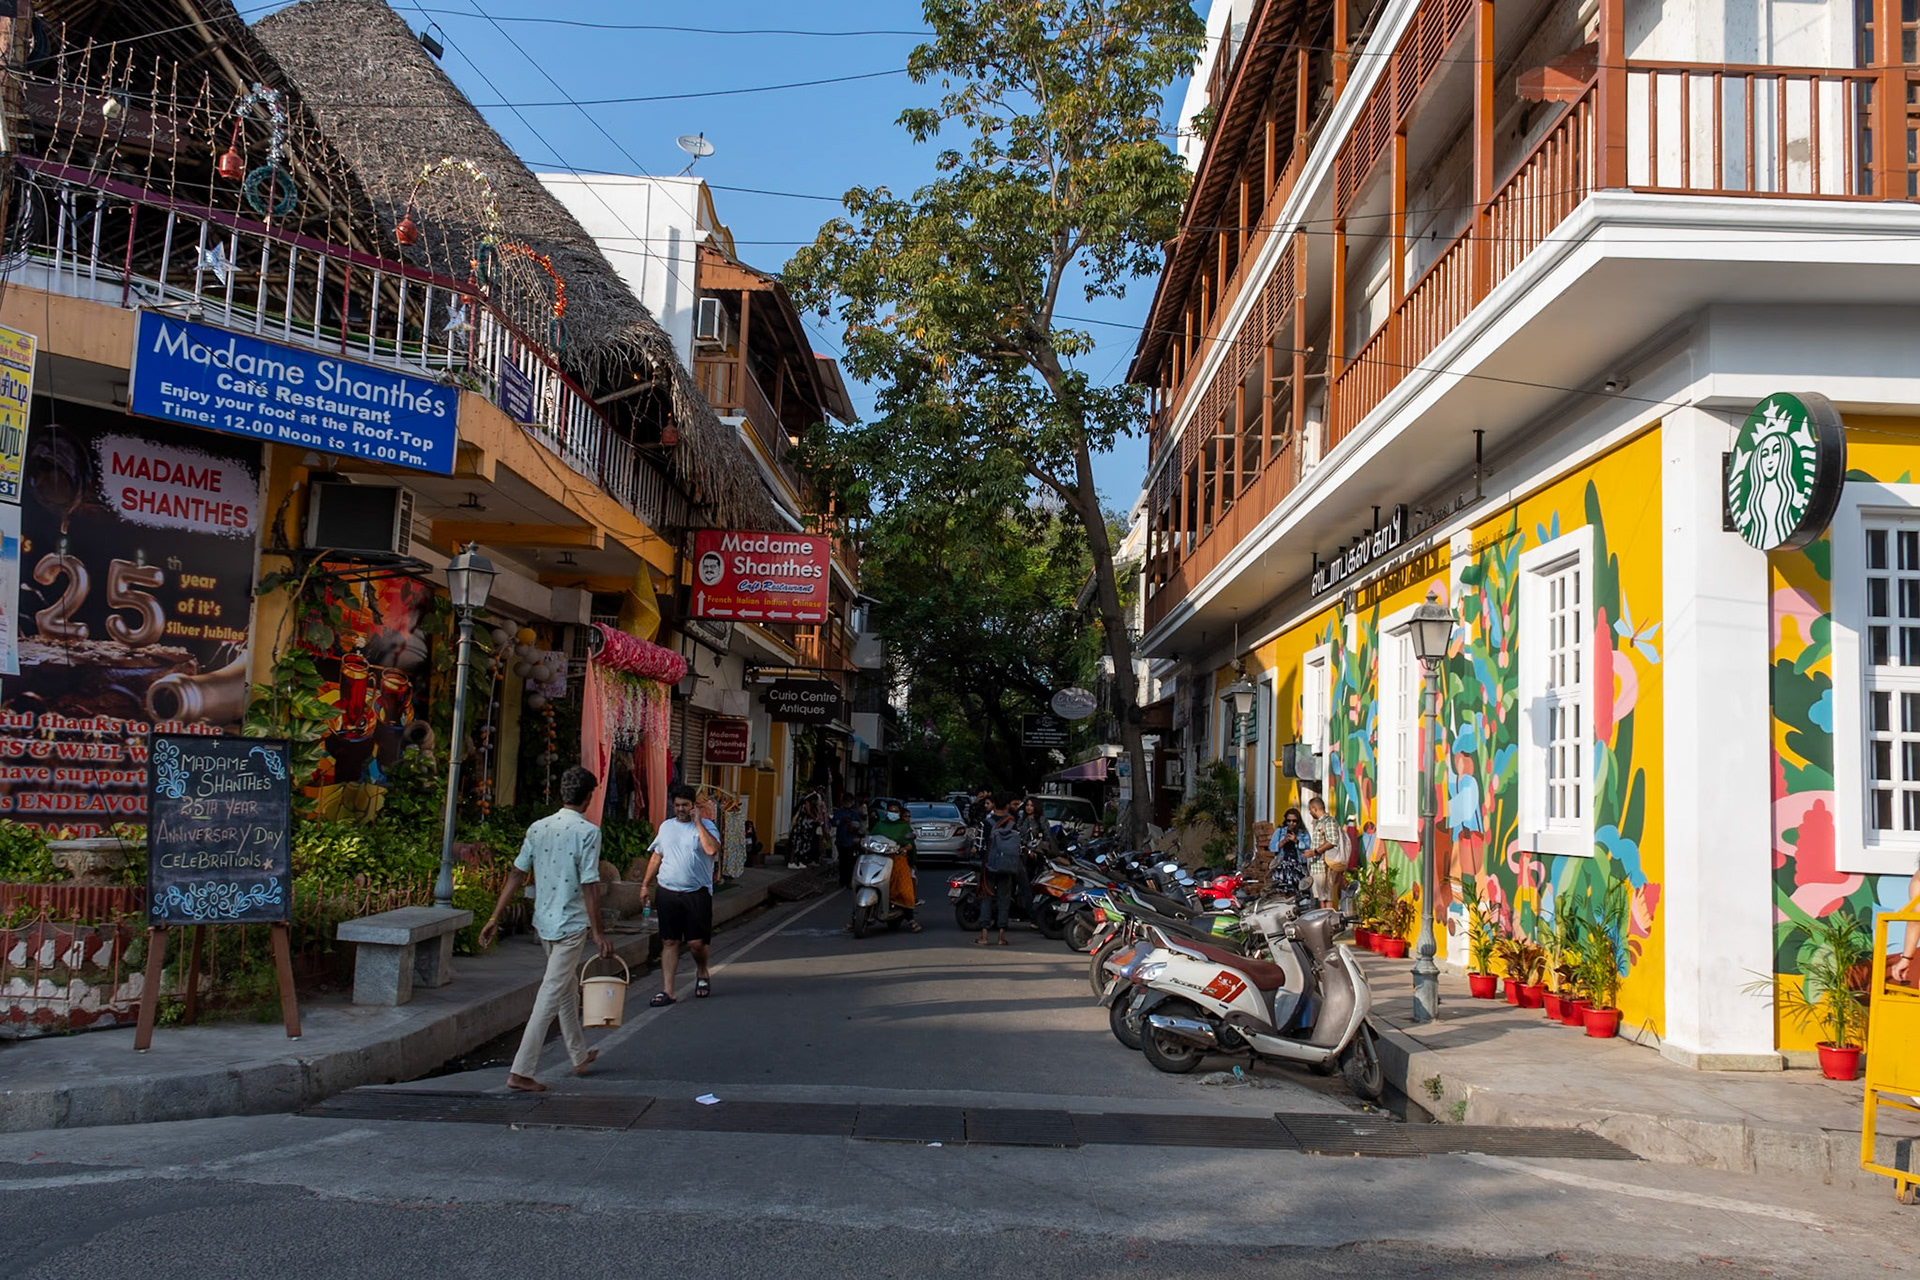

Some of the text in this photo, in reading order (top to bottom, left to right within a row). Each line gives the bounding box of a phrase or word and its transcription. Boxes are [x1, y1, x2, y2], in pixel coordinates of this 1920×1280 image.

[153, 322, 305, 385] Madame
[315, 360, 446, 417] Shanthés
[217, 373, 391, 425] Café Restaurant
[160, 381, 433, 451] Enjoy your food at the Roof-Top
[162, 401, 427, 466] Time: 12.00 Noon to 11.00 Pm.
[112, 451, 222, 493] MADAME
[121, 487, 249, 528] SHANTHÉS
[720, 533, 813, 555] Madame
[733, 556, 822, 578] Shanthés
[180, 574, 216, 589] year
[762, 580, 814, 593] Restaurant
[33, 552, 165, 648] 25
[178, 598, 221, 617] of it's
[707, 595, 822, 608] French Italian Indian Chinese
[166, 621, 245, 641] Silver Jubilee
[769, 689, 837, 703] Curio Centre
[779, 703, 826, 715] Antiques
[40, 713, 120, 733] thanks
[127, 720, 149, 733] to
[154, 720, 183, 733] all
[189, 722, 222, 735] the
[709, 731, 740, 739] Madame
[30, 742, 50, 757] &
[57, 743, 122, 760] WELL
[181, 754, 249, 773] MADAME
[225, 798, 259, 819] YEAR
